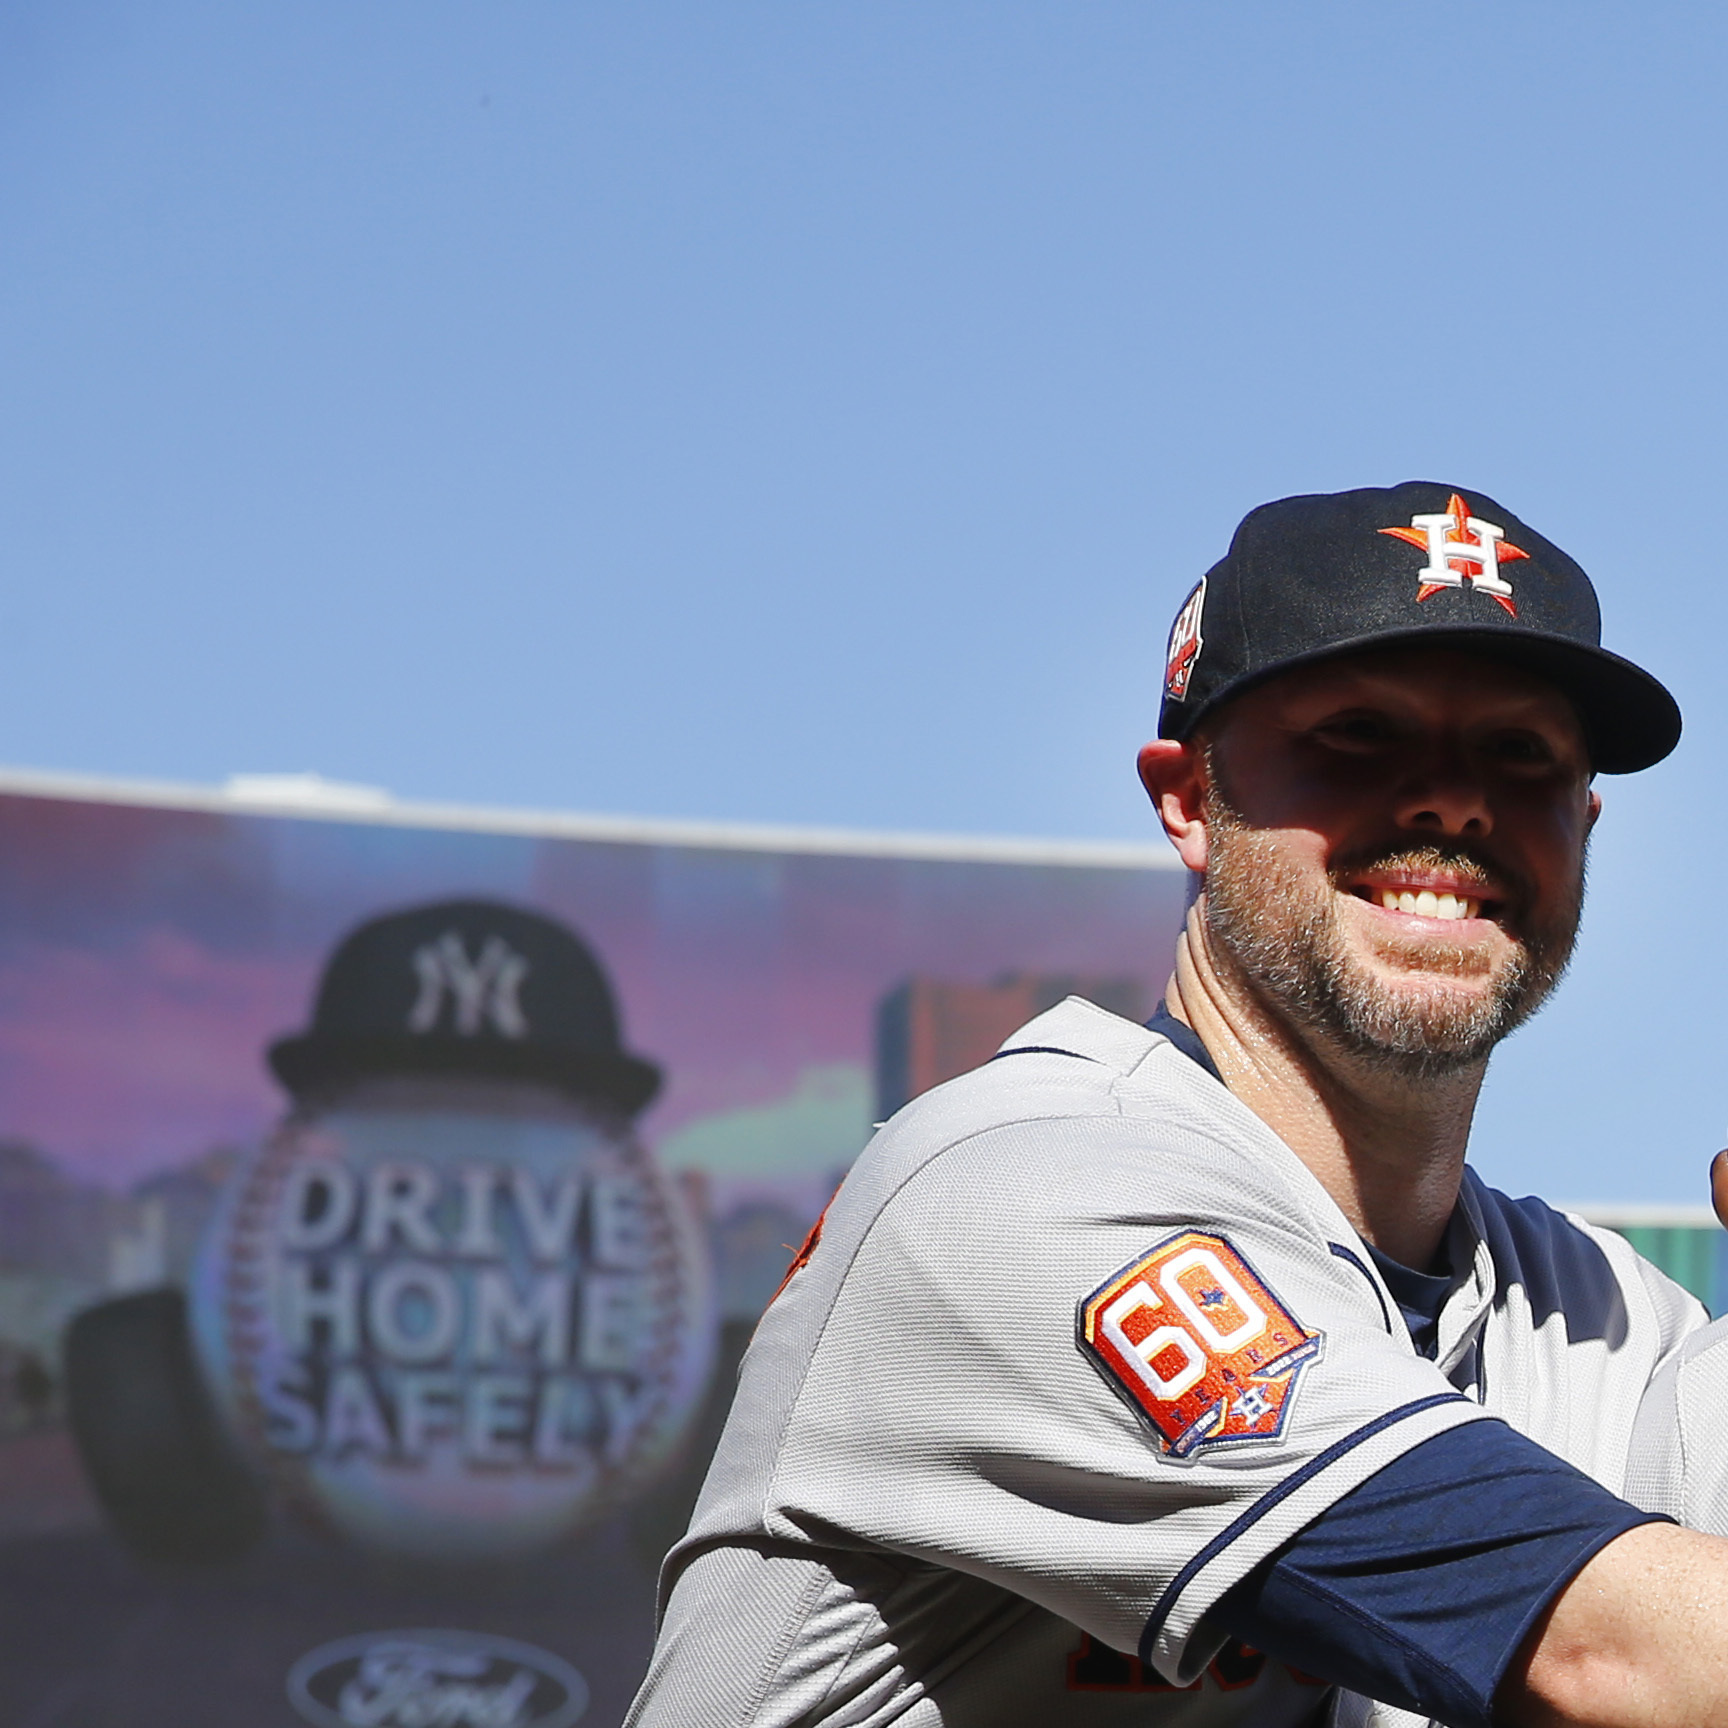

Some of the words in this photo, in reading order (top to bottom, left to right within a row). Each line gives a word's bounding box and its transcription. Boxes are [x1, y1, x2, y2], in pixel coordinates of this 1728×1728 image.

[1410, 513, 1514, 599] H
[280, 1160, 643, 1264] DRIVE
[288, 1260, 643, 1371] HOME
[1101, 1247, 1266, 1401] 60
[266, 1364, 653, 1463] SAFELY
[1169, 1332, 1289, 1425] YEARS
